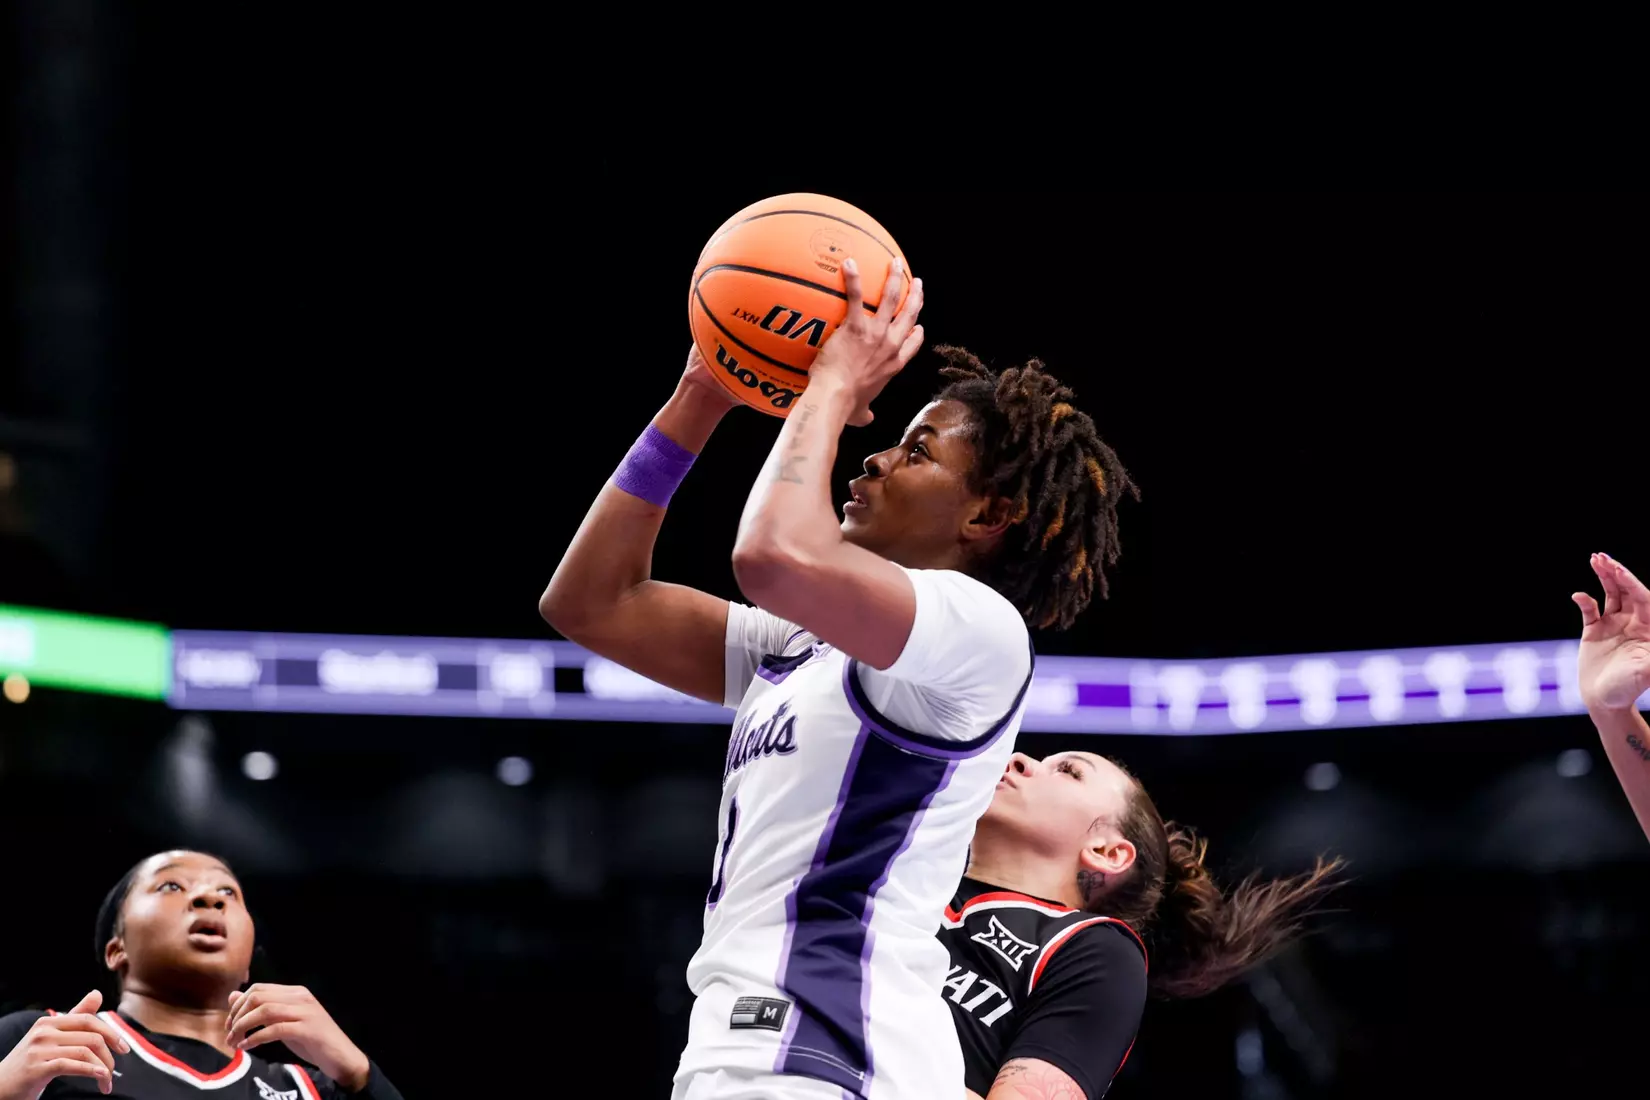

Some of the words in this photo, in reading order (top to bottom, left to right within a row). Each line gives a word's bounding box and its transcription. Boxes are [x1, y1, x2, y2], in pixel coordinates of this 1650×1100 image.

[731, 308, 761, 325] NXT
[759, 304, 828, 349] VO
[715, 343, 802, 409] lson
[762, 1006, 778, 1020] M
